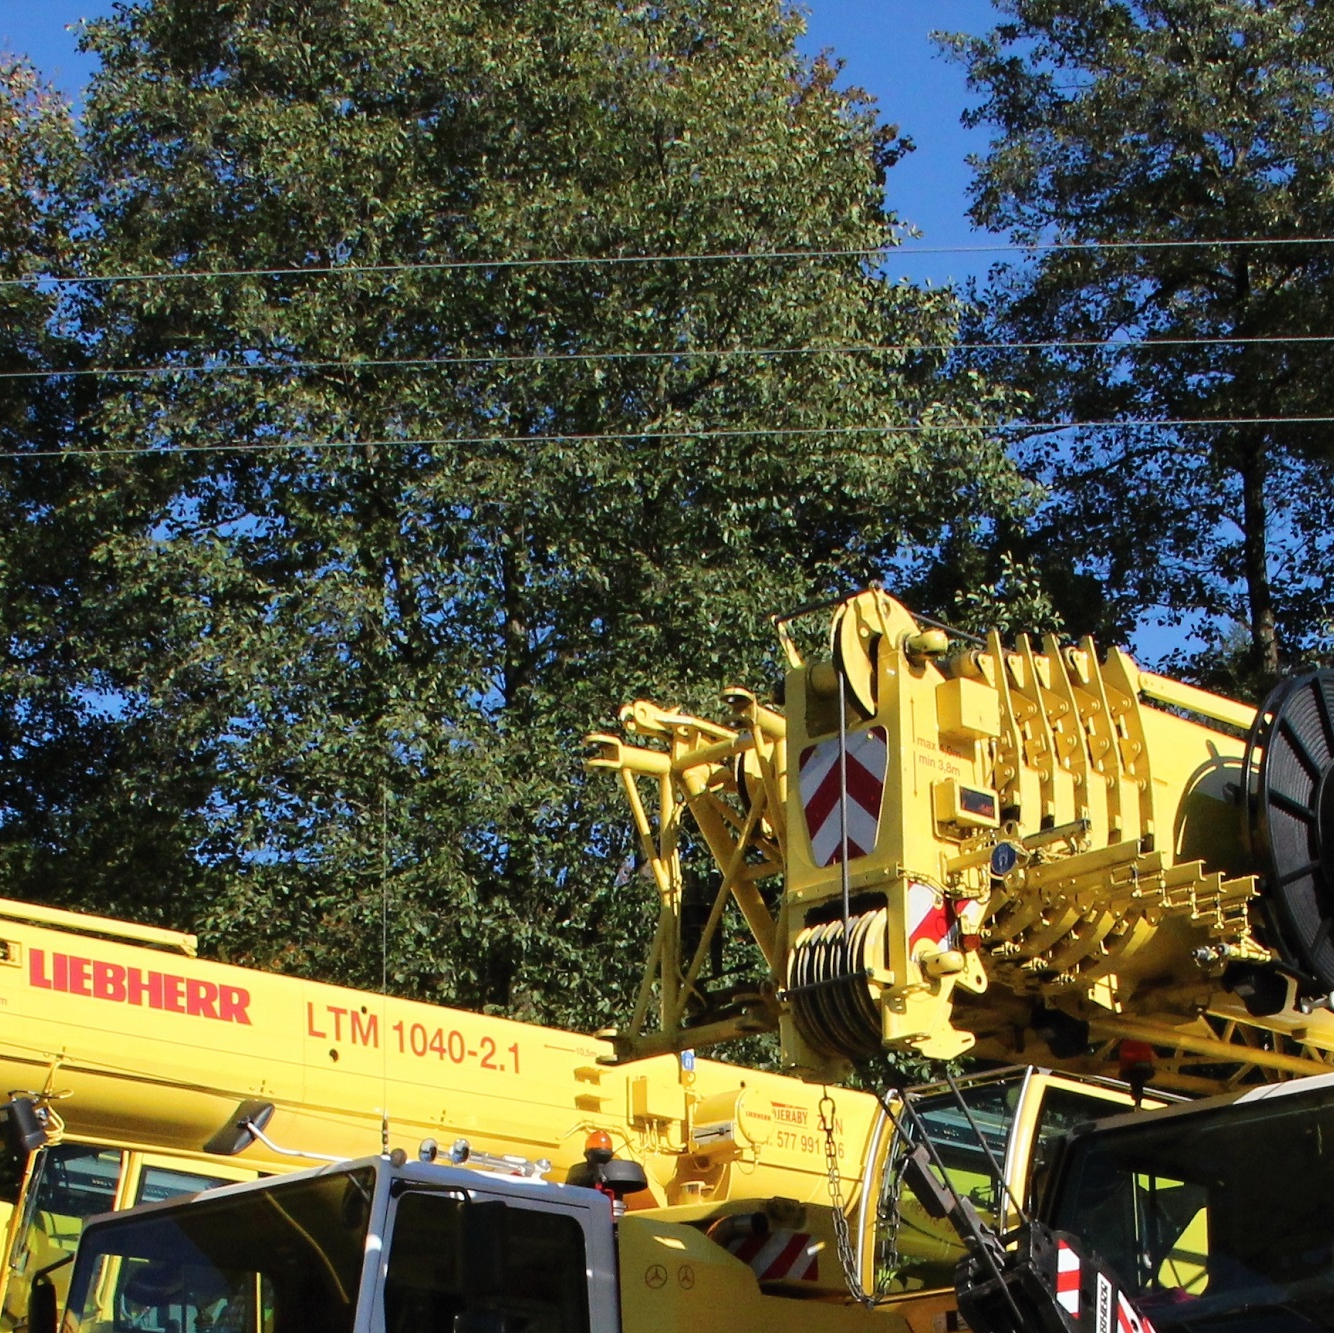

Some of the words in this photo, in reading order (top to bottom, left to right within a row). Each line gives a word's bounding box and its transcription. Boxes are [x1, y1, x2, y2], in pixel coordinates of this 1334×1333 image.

[918, 754, 936, 768] min
[938, 760, 961, 776] 3,8m
[29, 947, 253, 1026] LIEBHERR
[307, 1001, 379, 1049] LTM
[392, 1020, 520, 1074] 1040-2.1
[772, 1108, 808, 1125] JERABY
[817, 1114, 843, 1135] ZN
[777, 1130, 797, 1150] 577
[800, 1135, 820, 1154] 991
